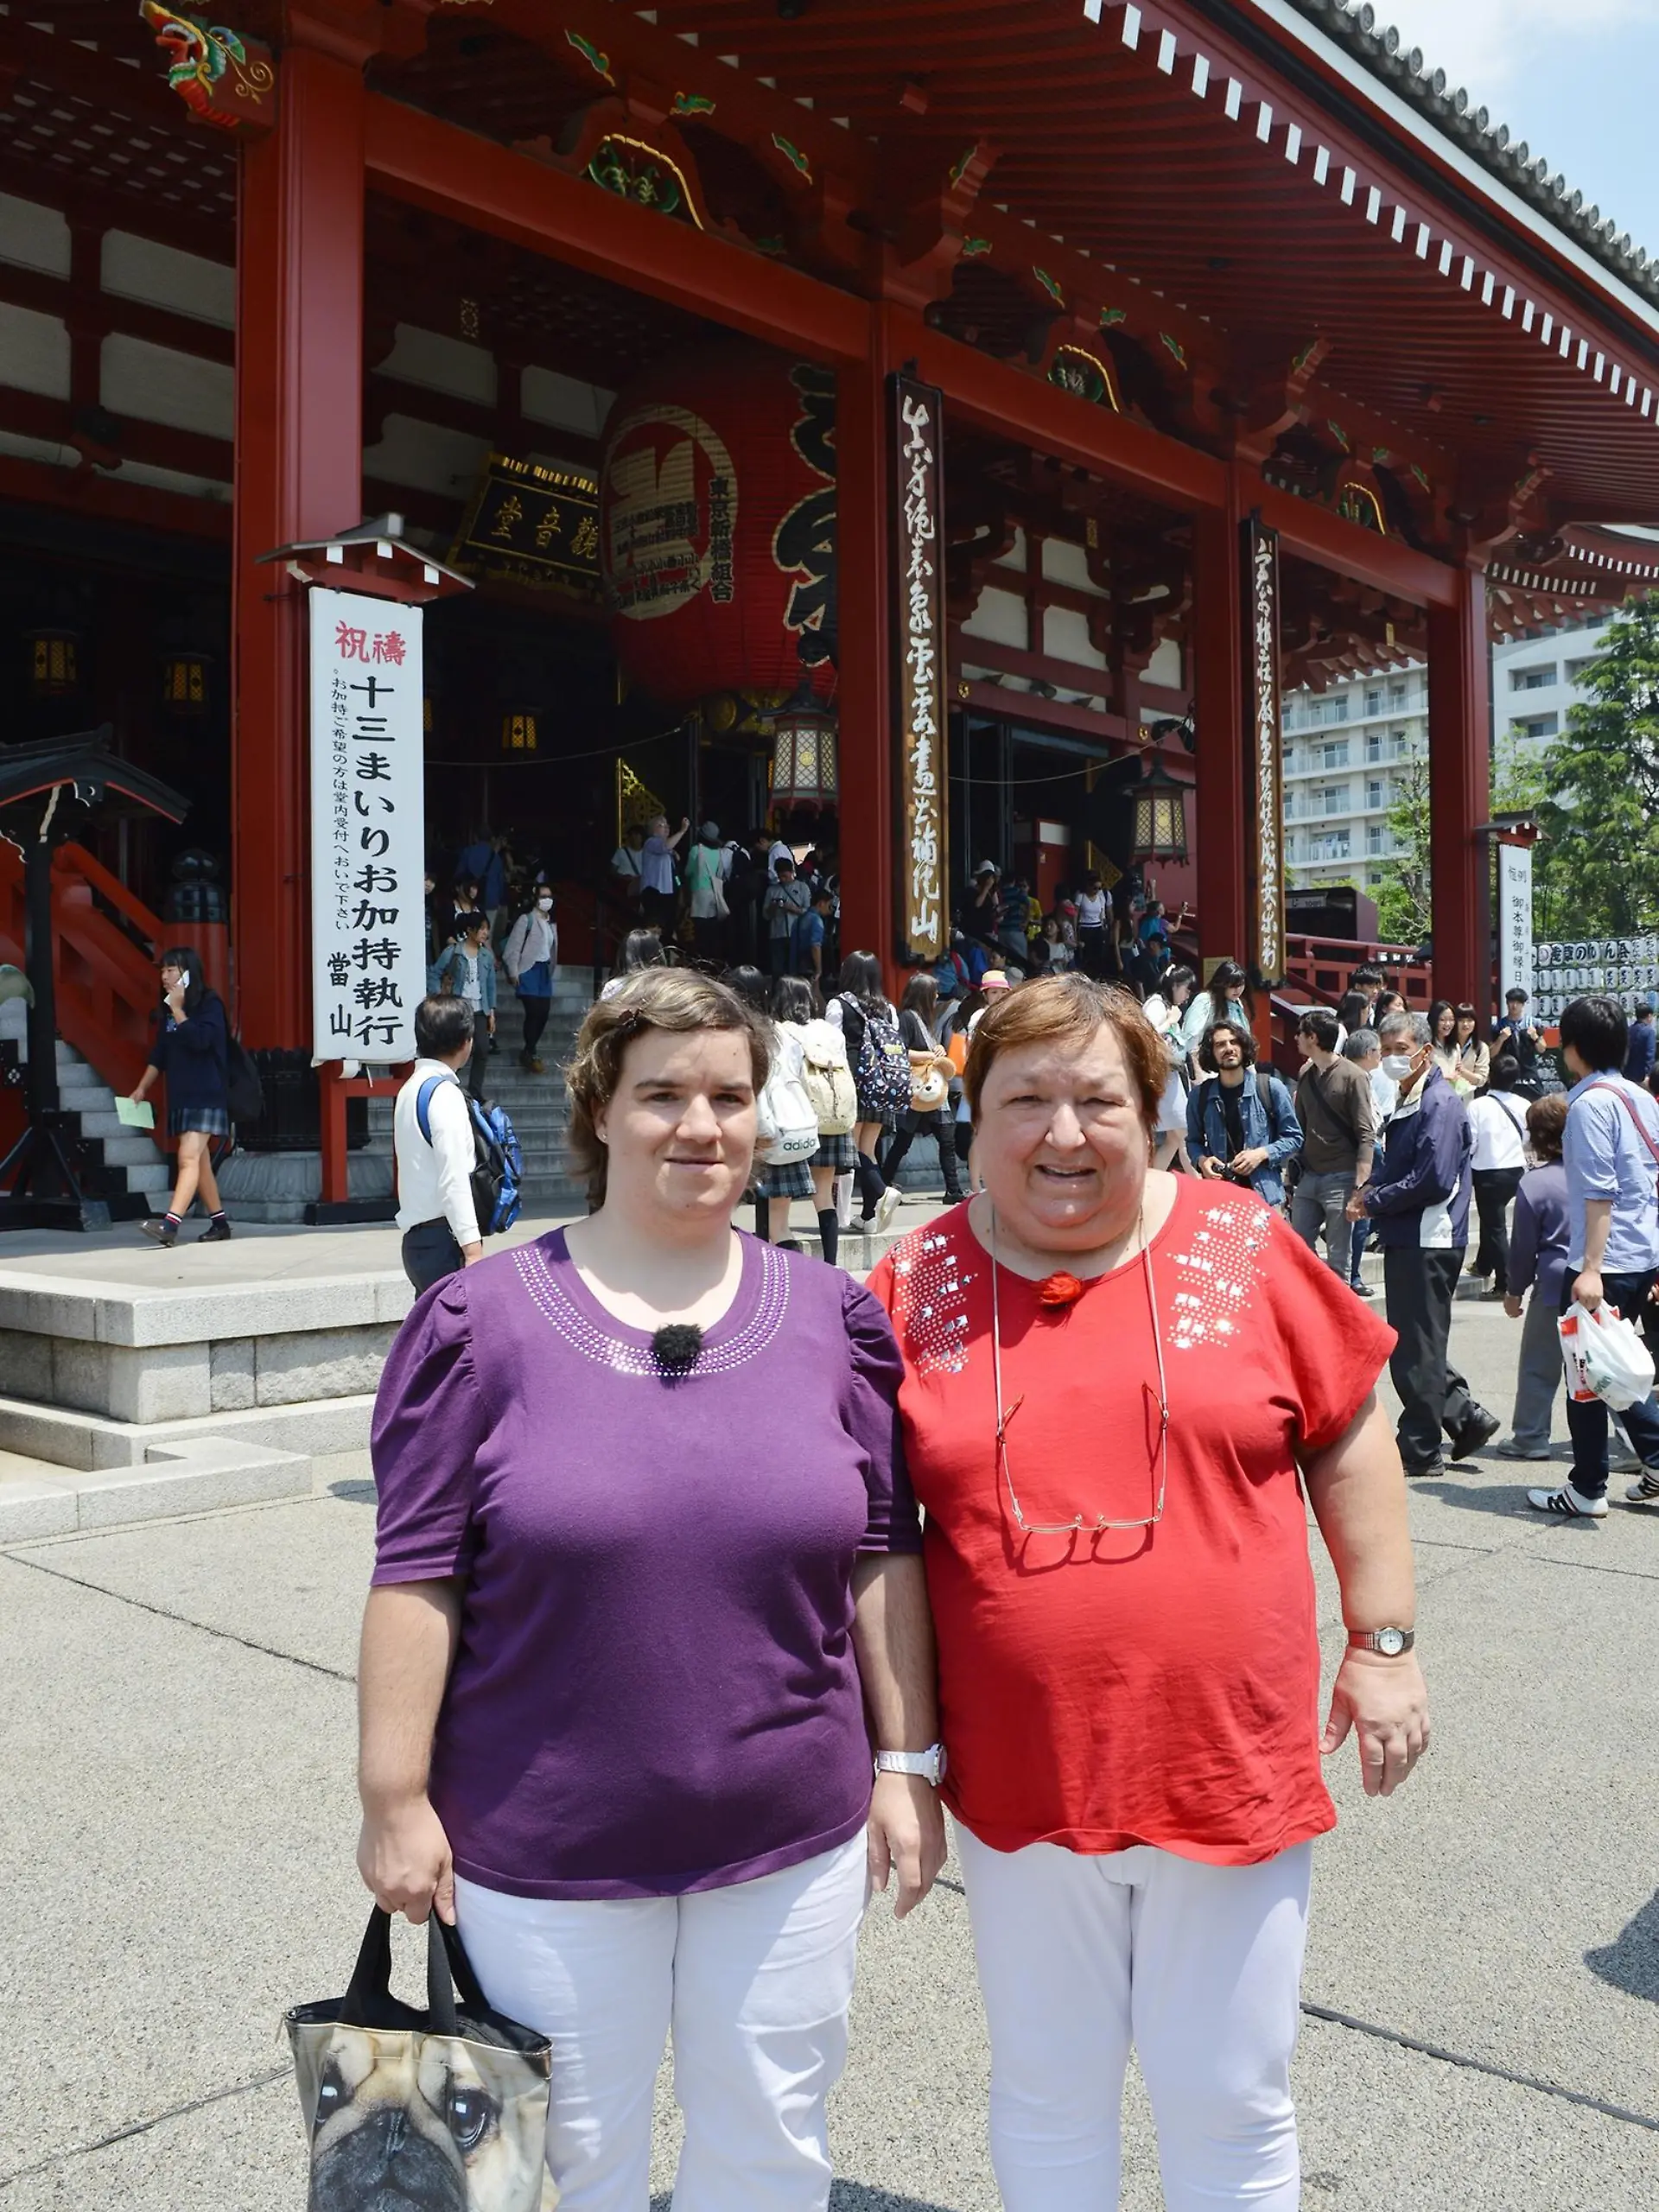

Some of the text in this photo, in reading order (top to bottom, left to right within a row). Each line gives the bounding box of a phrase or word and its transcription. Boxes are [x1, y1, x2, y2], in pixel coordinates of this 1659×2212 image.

[709, 476, 734, 603] 東京新橋組合
[350, 676, 404, 1046] 十三まいりお加持執行
[1512, 895, 1524, 986] 御本尊御縁日
